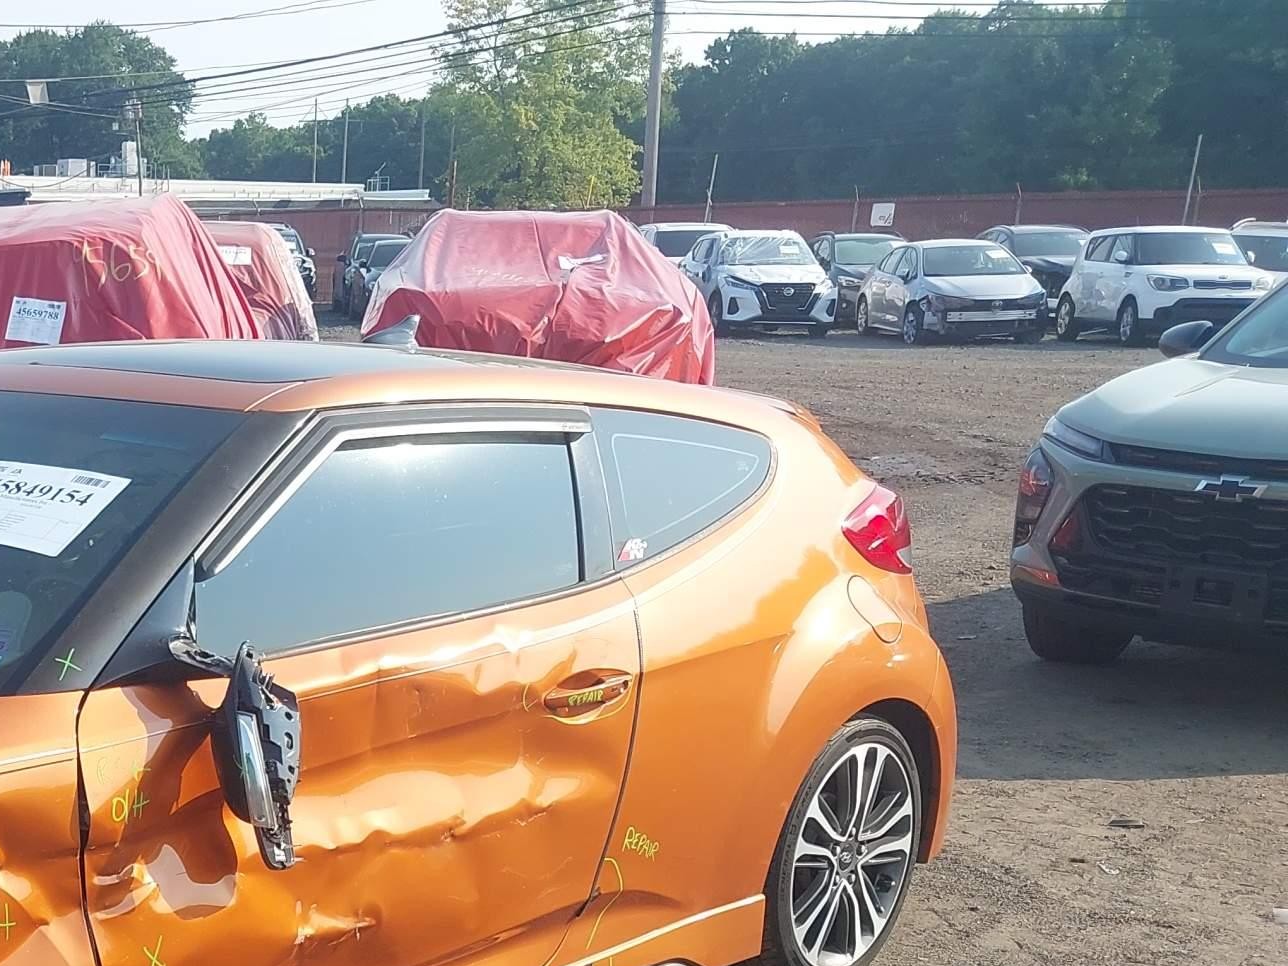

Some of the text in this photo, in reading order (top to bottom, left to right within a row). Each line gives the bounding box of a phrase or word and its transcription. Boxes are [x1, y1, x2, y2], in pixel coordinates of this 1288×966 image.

[16, 307, 60, 320] 45659788
[568, 689, 604, 706] REPAIR
[622, 826, 660, 861] REPAIR
